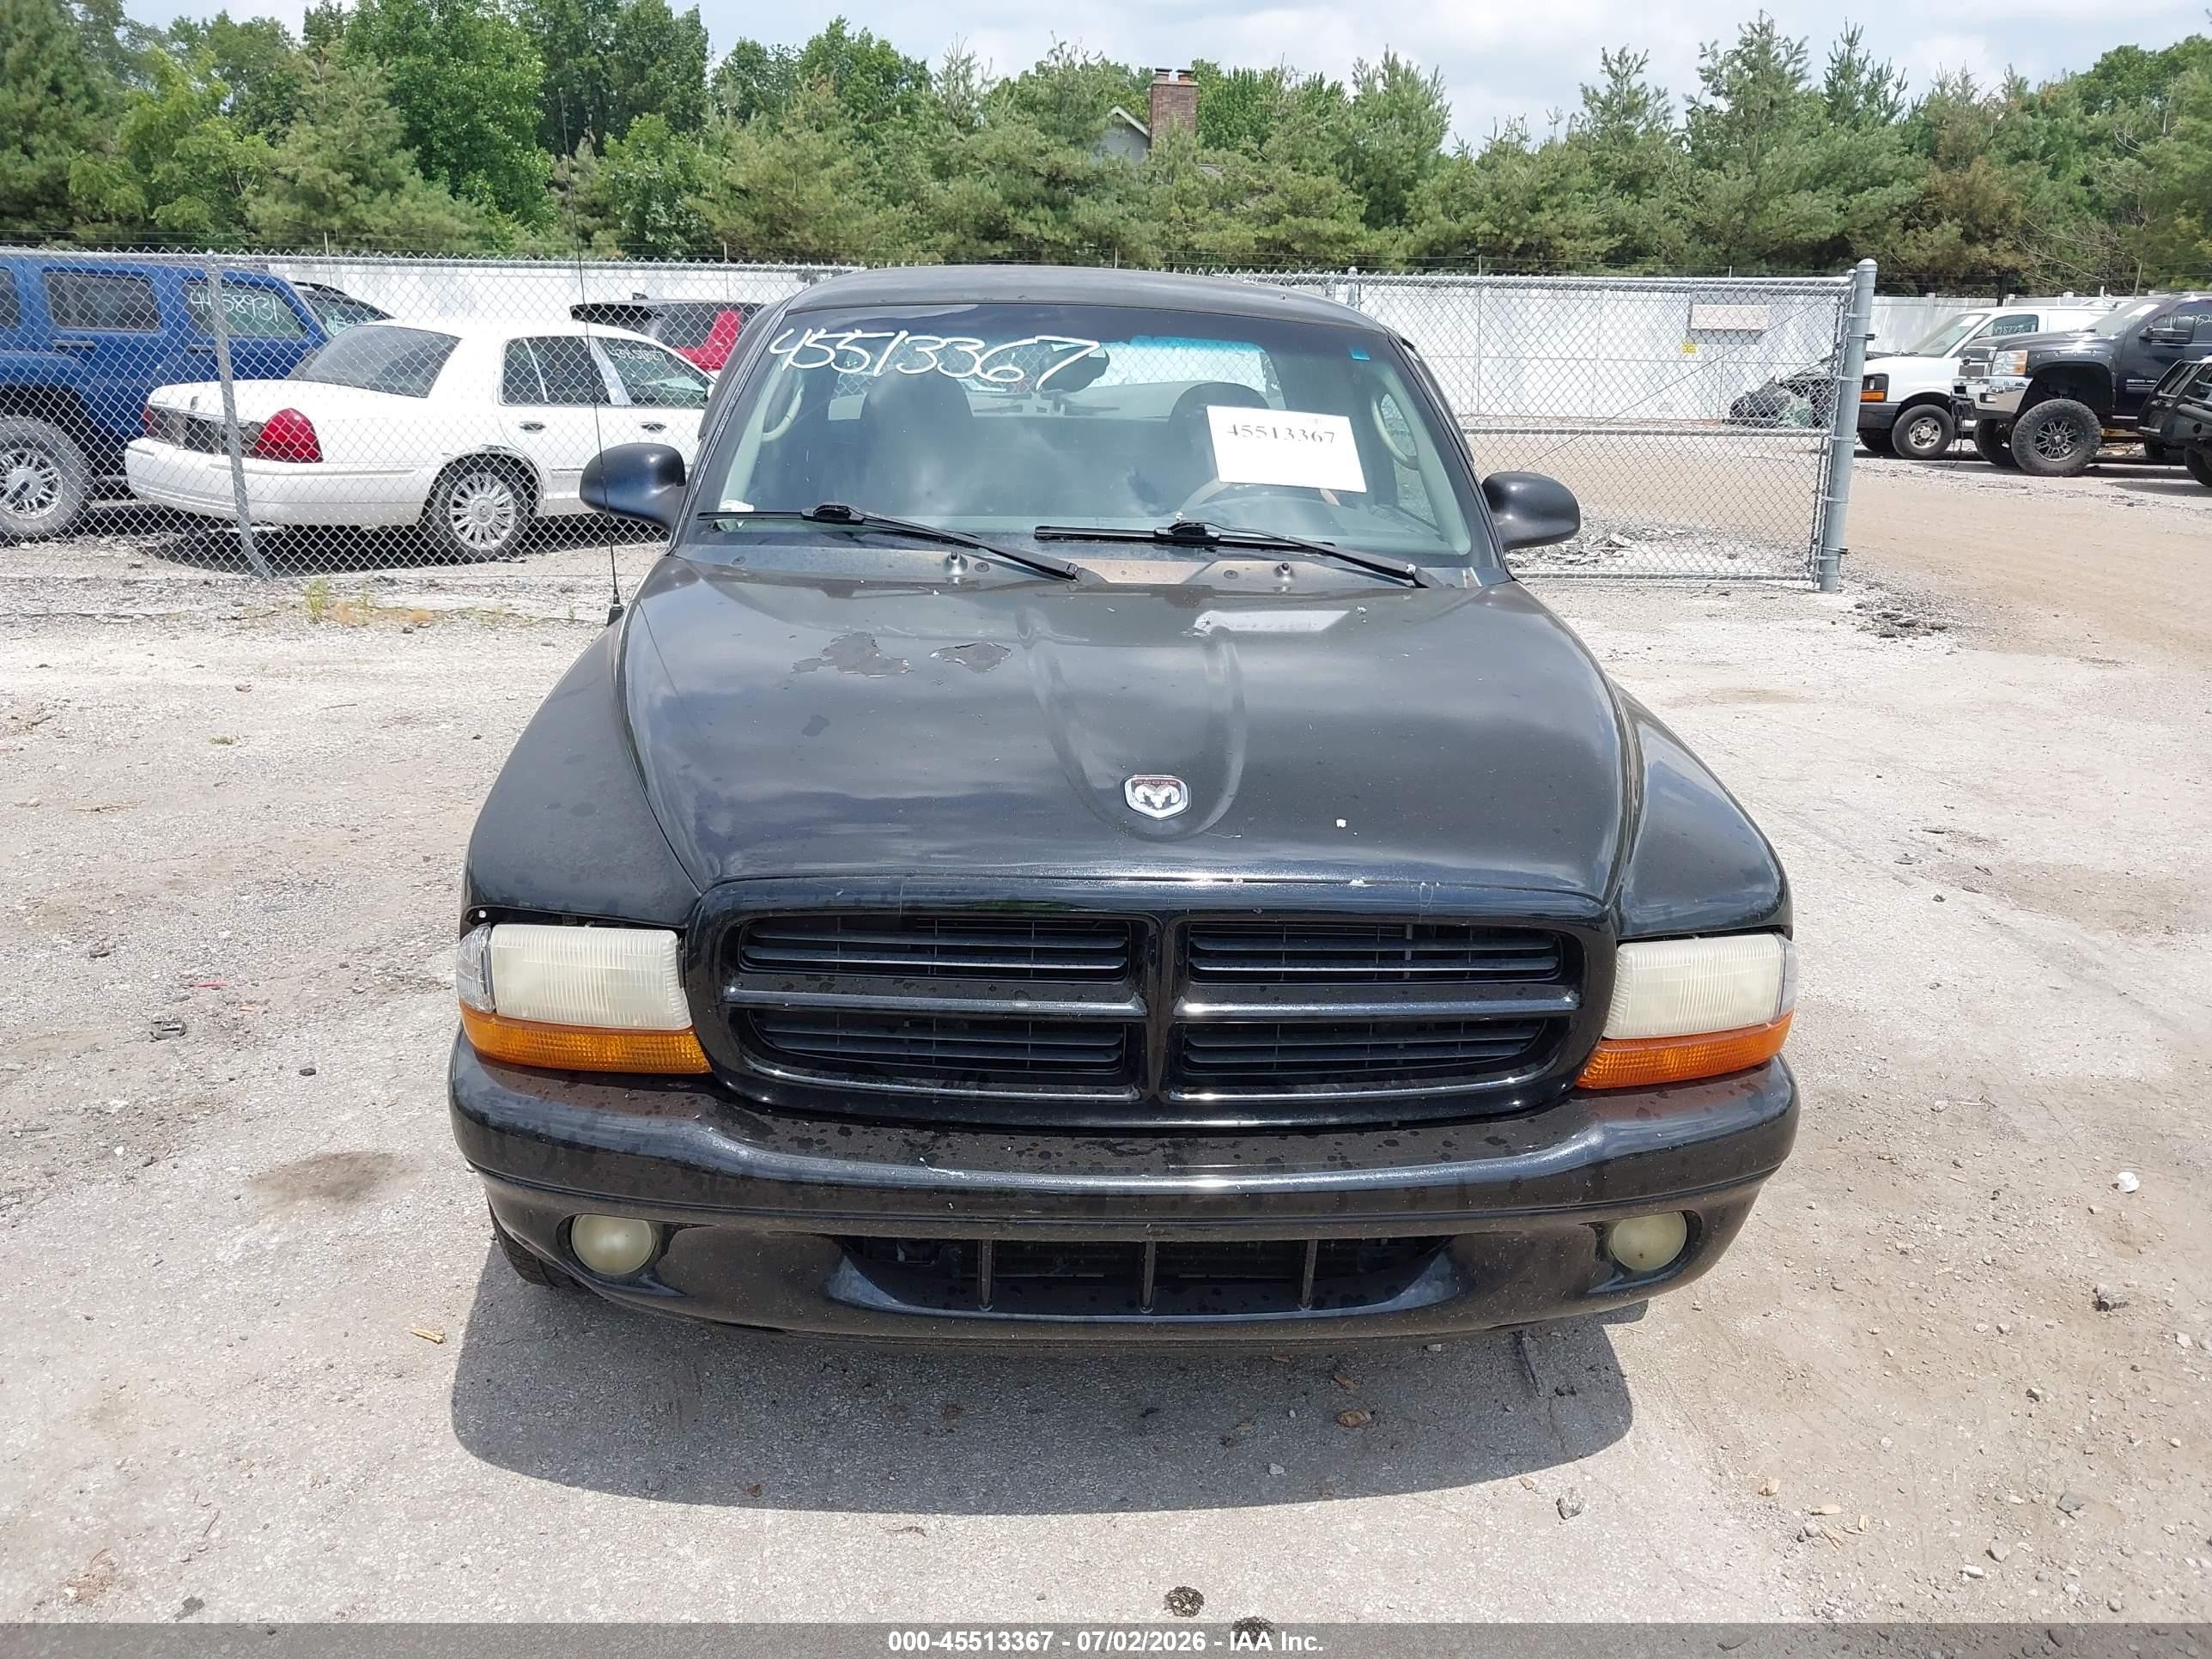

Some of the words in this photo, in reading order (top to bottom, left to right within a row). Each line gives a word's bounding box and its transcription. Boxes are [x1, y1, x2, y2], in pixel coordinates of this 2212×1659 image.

[190, 291, 278, 323] 4458931
[769, 328, 1100, 392] 45513367
[1227, 423, 1334, 444] 45513367
